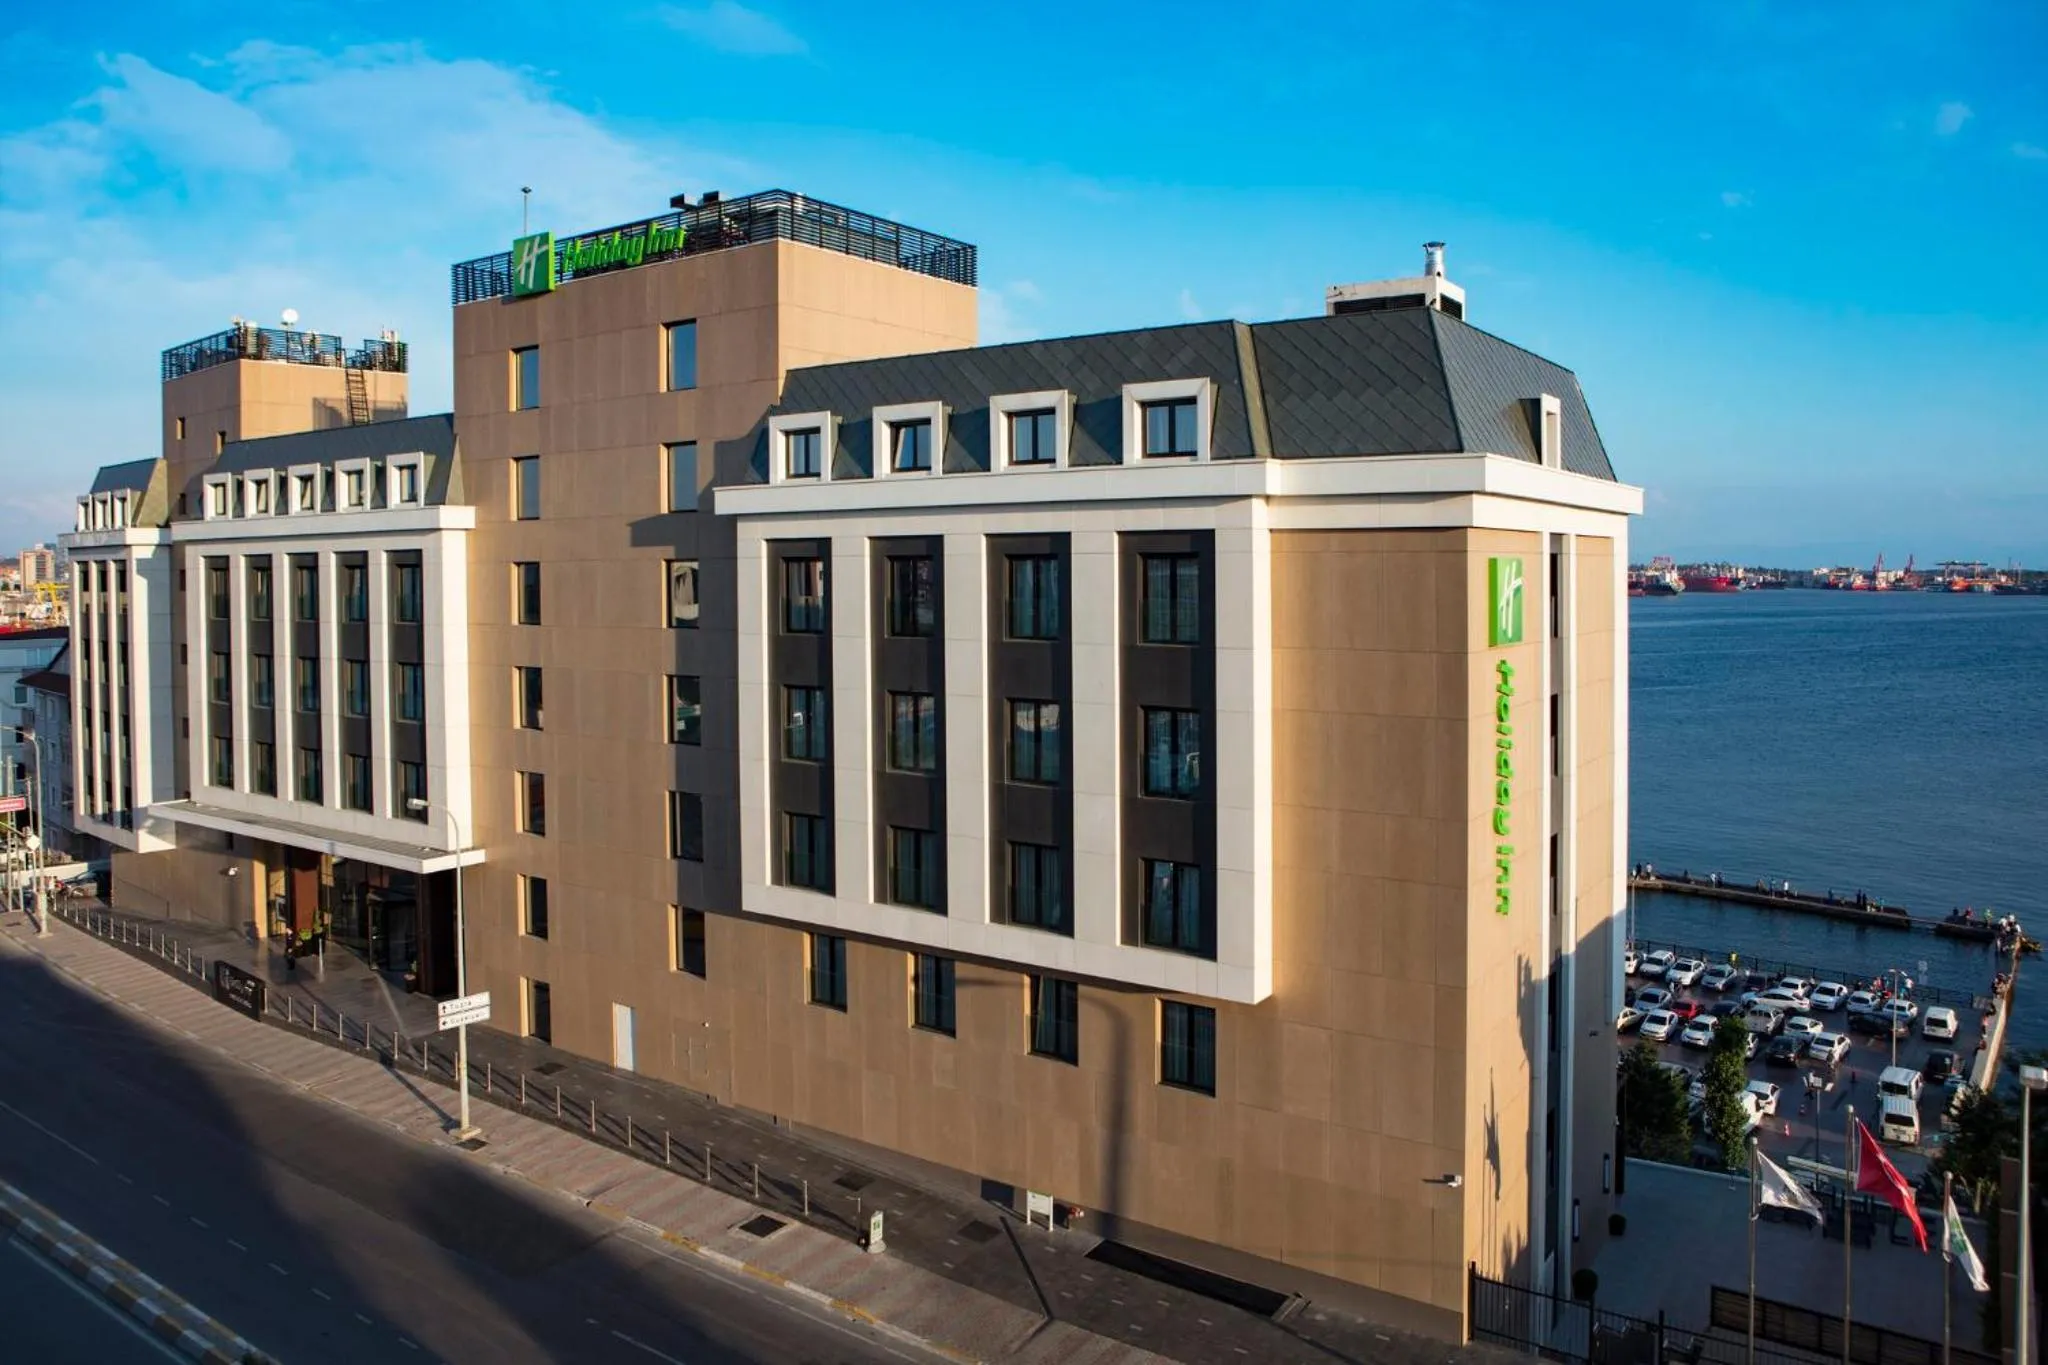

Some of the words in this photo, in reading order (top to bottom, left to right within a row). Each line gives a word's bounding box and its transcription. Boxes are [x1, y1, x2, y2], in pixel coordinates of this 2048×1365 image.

[564, 231, 646, 273] Holiday
[648, 221, 686, 255] Inn
[1492, 659, 1515, 836] Holiday
[1495, 845, 1515, 916] Inn
